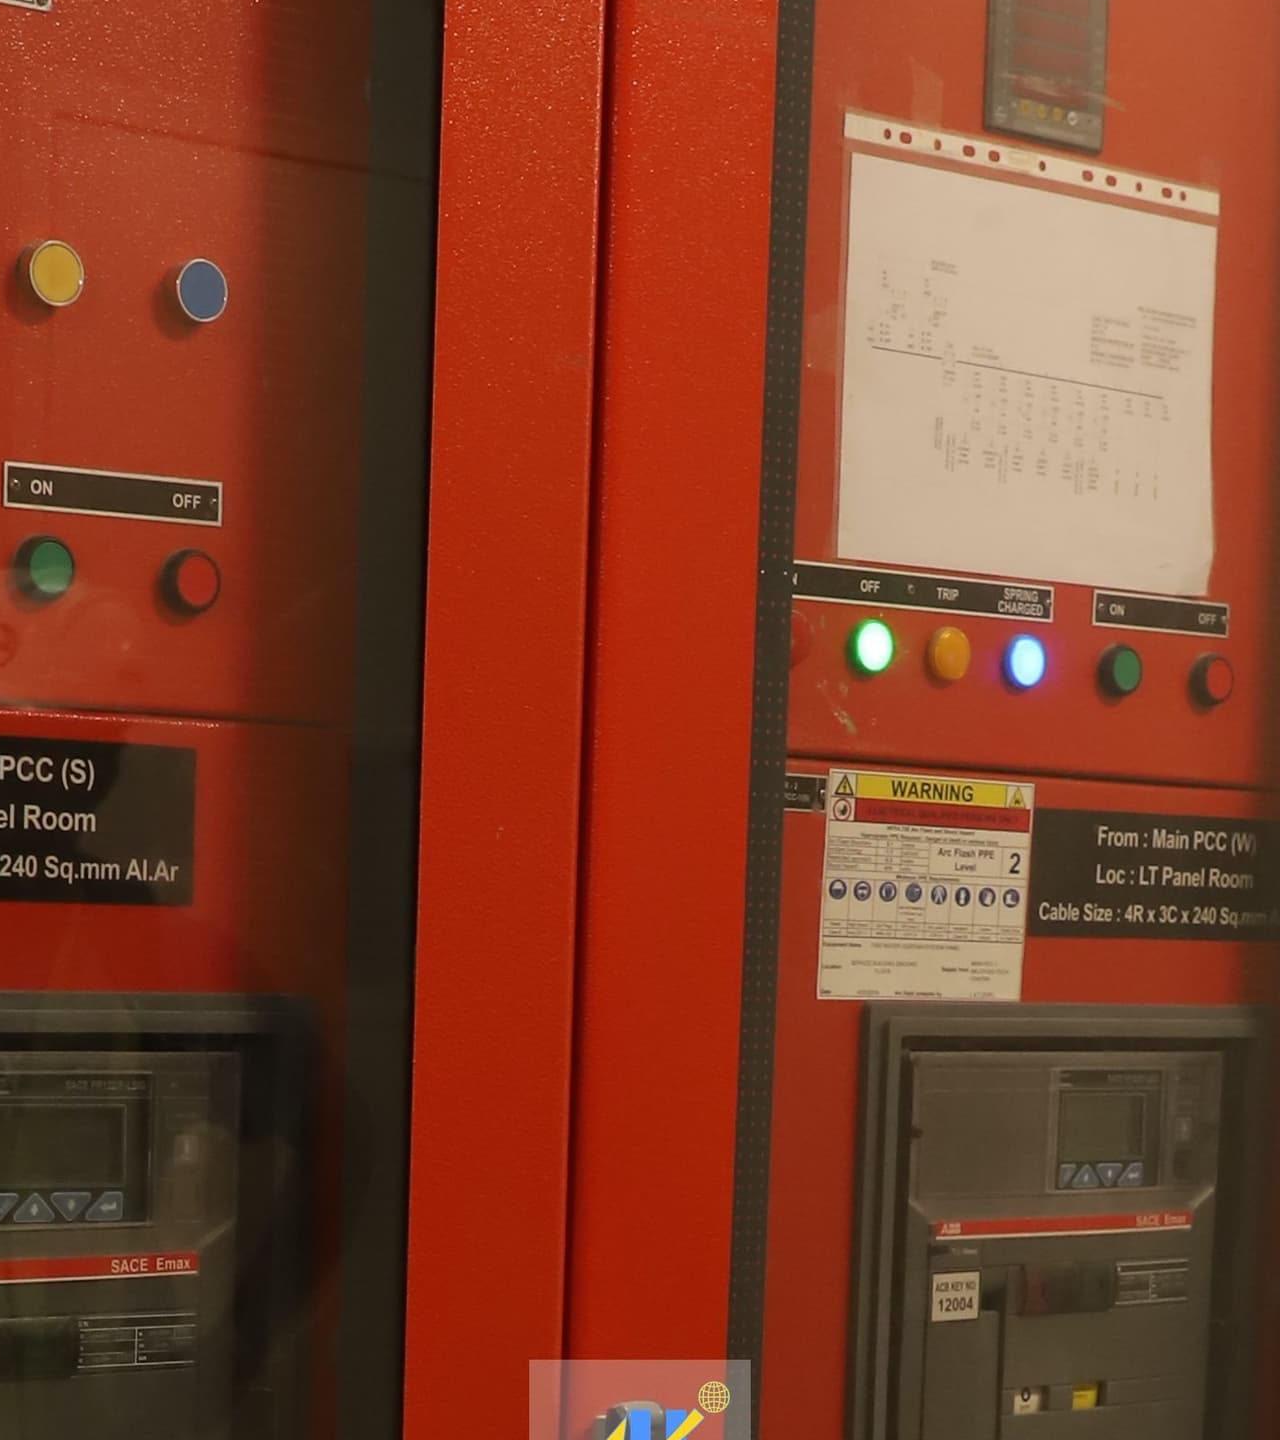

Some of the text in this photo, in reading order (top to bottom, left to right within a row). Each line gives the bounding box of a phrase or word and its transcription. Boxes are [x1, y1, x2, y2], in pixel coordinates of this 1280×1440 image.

[30, 479, 202, 510] ON OFF
[860, 579, 959, 601] OFF TRIP
[1003, 587, 1039, 603] SPRING
[997, 600, 1043, 617] CHARGED
[1109, 603, 1217, 625] ON OFF
[61, 758, 95, 791] (S)
[891, 780, 974, 802] WARNING
[23, 804, 96, 832] Room
[1097, 826, 1138, 848] From
[1152, 828, 1189, 850] Main
[1193, 830, 1226, 851] PCC
[0, 854, 38, 879] 240
[44, 856, 120, 885] Sq.mm
[125, 859, 178, 882] Al.Ar
[937, 847, 1021, 874] Arc Flash PPE 2
[954, 862, 977, 873] Level
[1096, 864, 1126, 885] Loc
[1139, 865, 1159, 886] LT
[1162, 866, 1204, 887] Panel
[1209, 868, 1254, 889] Room
[1039, 902, 1079, 922] Cable
[1083, 903, 1113, 922] Size
[1124, 905, 1144, 923] 4R
[1147, 910, 1156, 923] x
[1159, 906, 1177, 924] 3C
[1180, 910, 1189, 924] x
[1192, 907, 1217, 925] 240
[111, 1256, 192, 1274] SACE Emax
[939, 1296, 973, 1312] 12004
